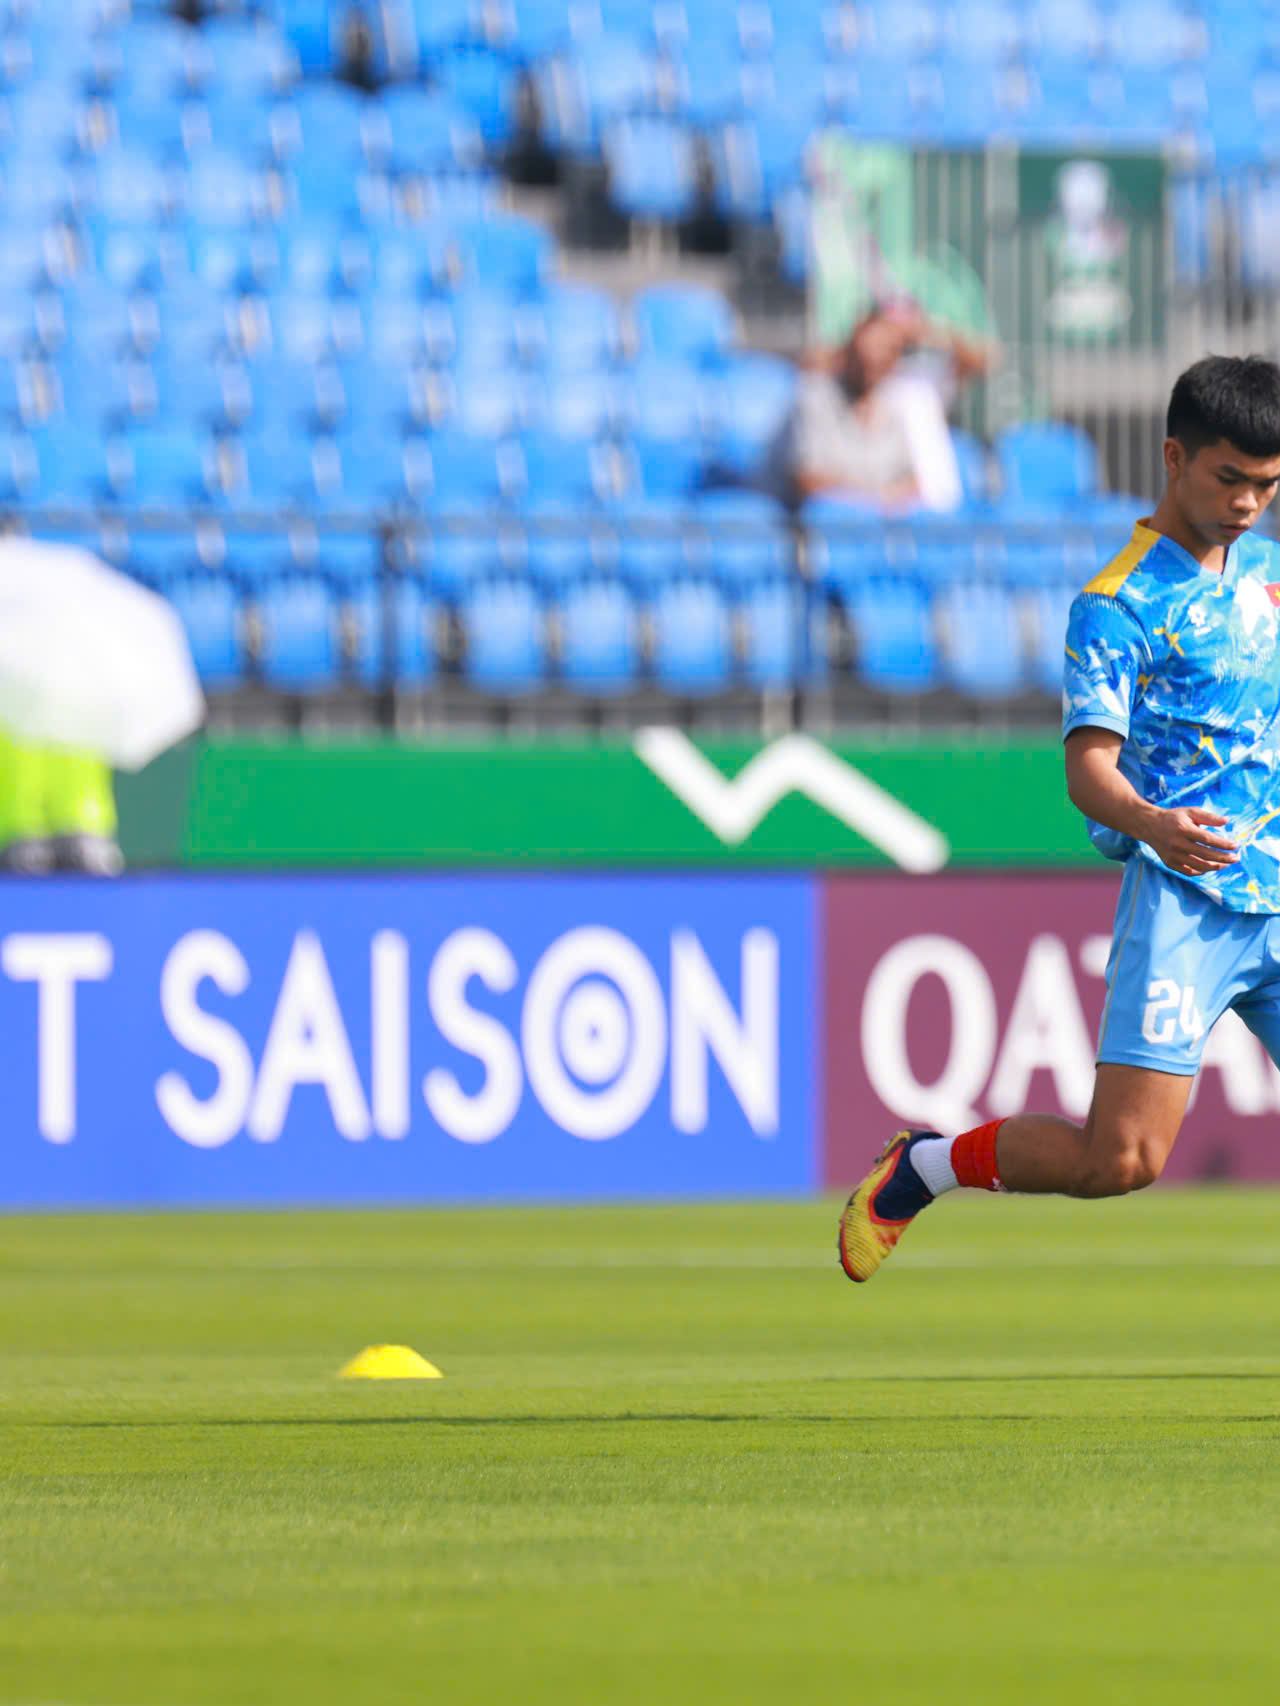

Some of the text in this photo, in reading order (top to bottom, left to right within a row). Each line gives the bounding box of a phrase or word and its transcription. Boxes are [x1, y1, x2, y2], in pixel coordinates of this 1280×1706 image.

[1, 926, 780, 1148] T SAISON
[1141, 978, 1206, 1051] 24
